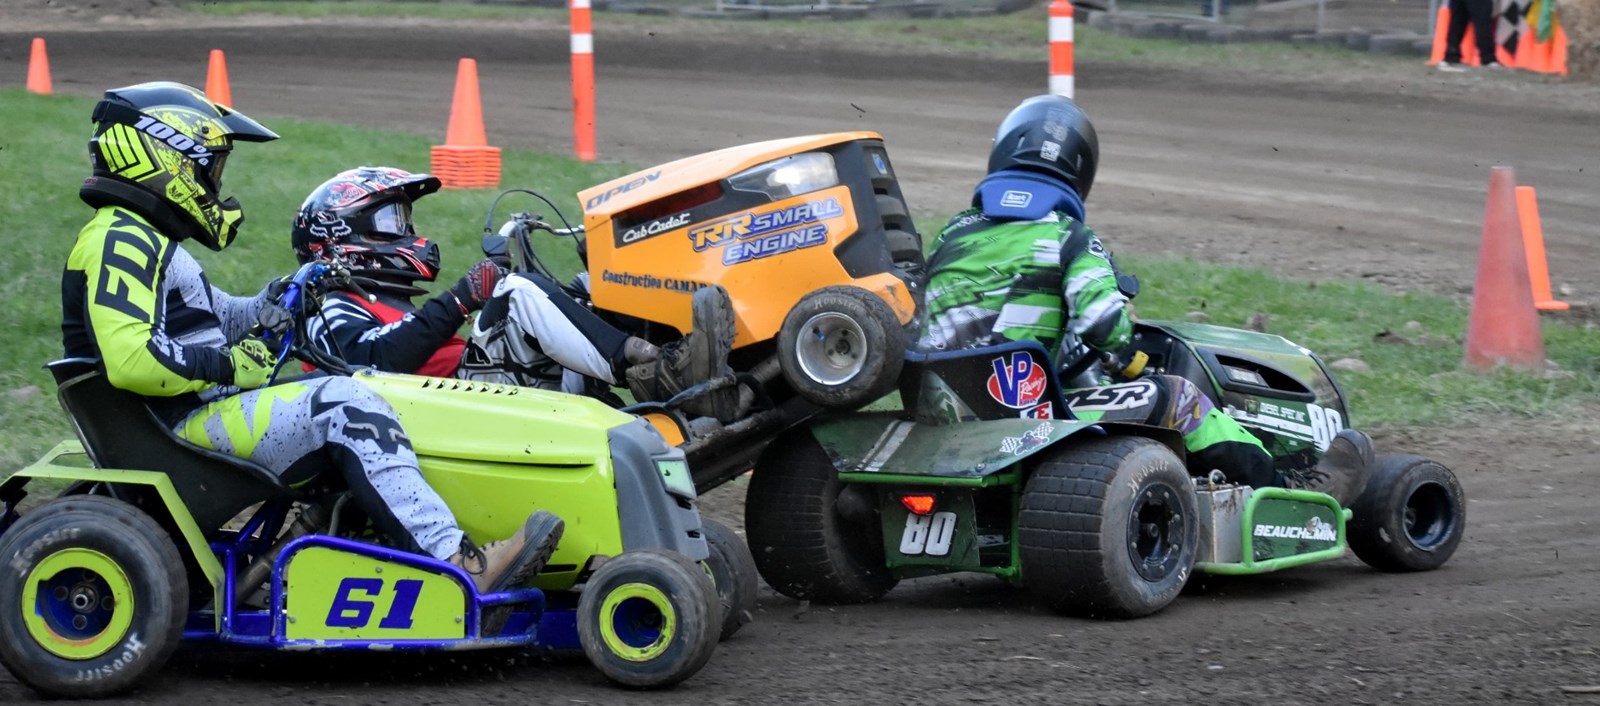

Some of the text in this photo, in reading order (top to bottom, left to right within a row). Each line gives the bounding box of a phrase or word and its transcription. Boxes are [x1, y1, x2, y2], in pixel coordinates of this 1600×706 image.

[134, 115, 214, 166] 100%
[622, 213, 691, 243] Cub Cadet
[690, 199, 843, 250] RR SMALL
[723, 225, 827, 266] ENGINE
[95, 208, 164, 325] FOX
[602, 269, 661, 289] Construction
[992, 351, 1033, 408] VP
[900, 511, 957, 555] 80
[1253, 523, 1338, 542] BEAUCHEMIN
[325, 577, 425, 630] 61
